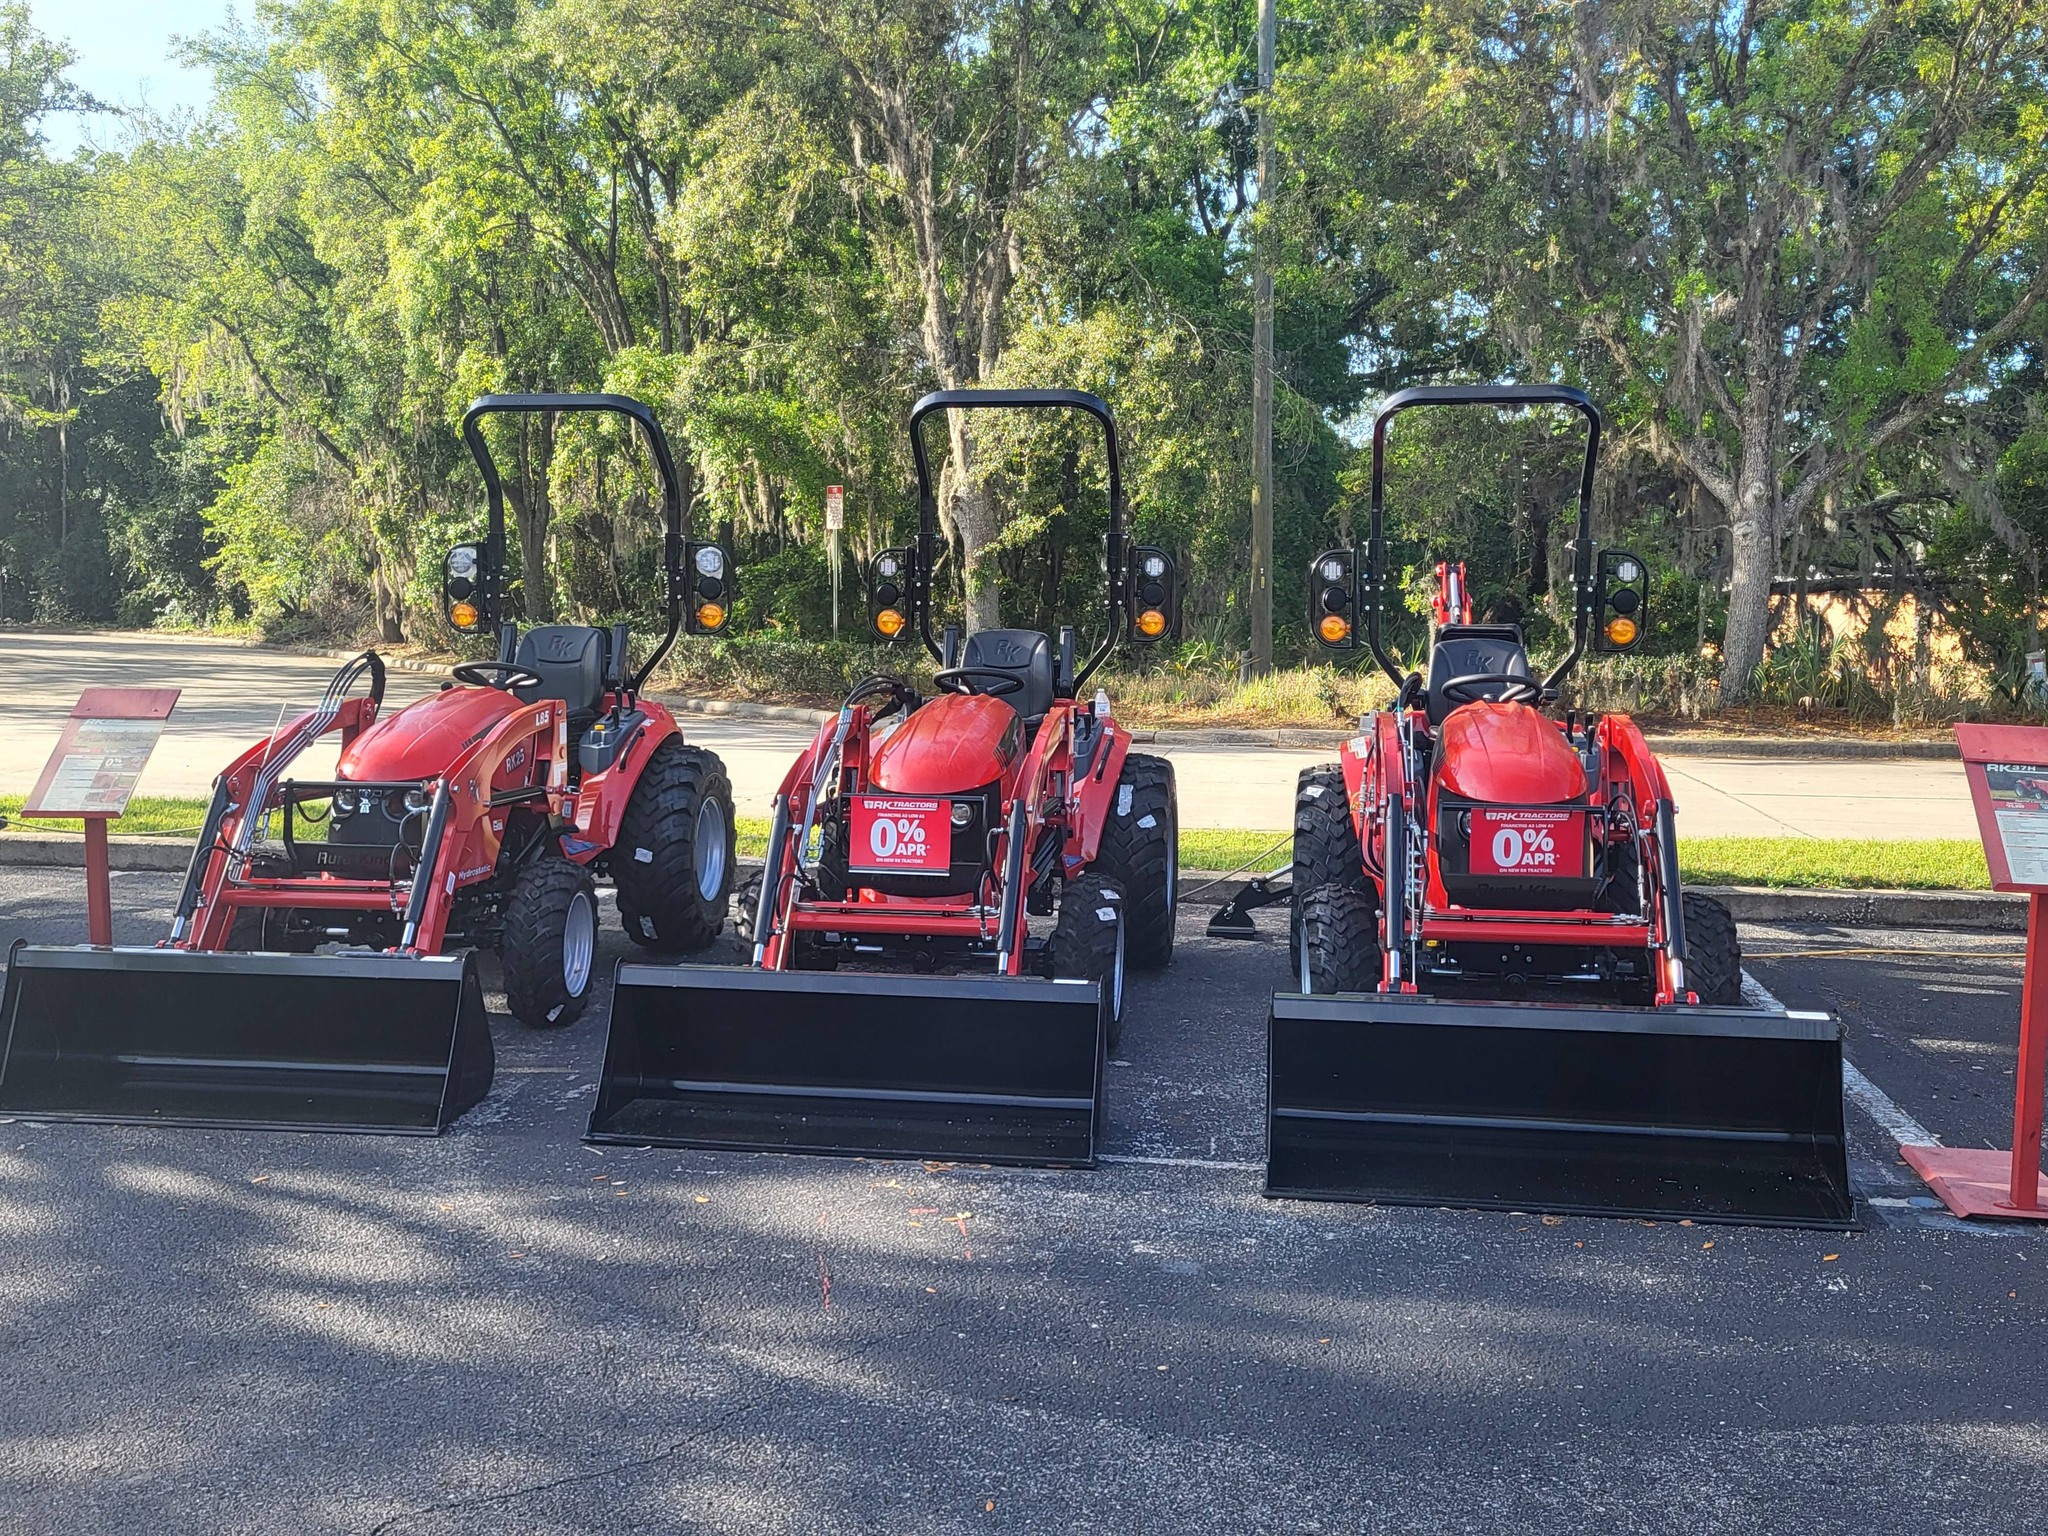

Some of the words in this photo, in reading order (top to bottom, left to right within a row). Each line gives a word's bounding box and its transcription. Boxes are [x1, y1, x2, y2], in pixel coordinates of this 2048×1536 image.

[550, 635, 577, 658] RK
[996, 640, 1023, 663] RK
[535, 710, 550, 727] L85
[505, 747, 525, 774] RK25
[893, 801, 938, 809] TRACTORS
[1519, 812, 1570, 820] TRACTORS
[870, 818, 926, 857] 0%
[1492, 828, 1555, 868] 0%
[458, 863, 492, 880] Hydrostatic
